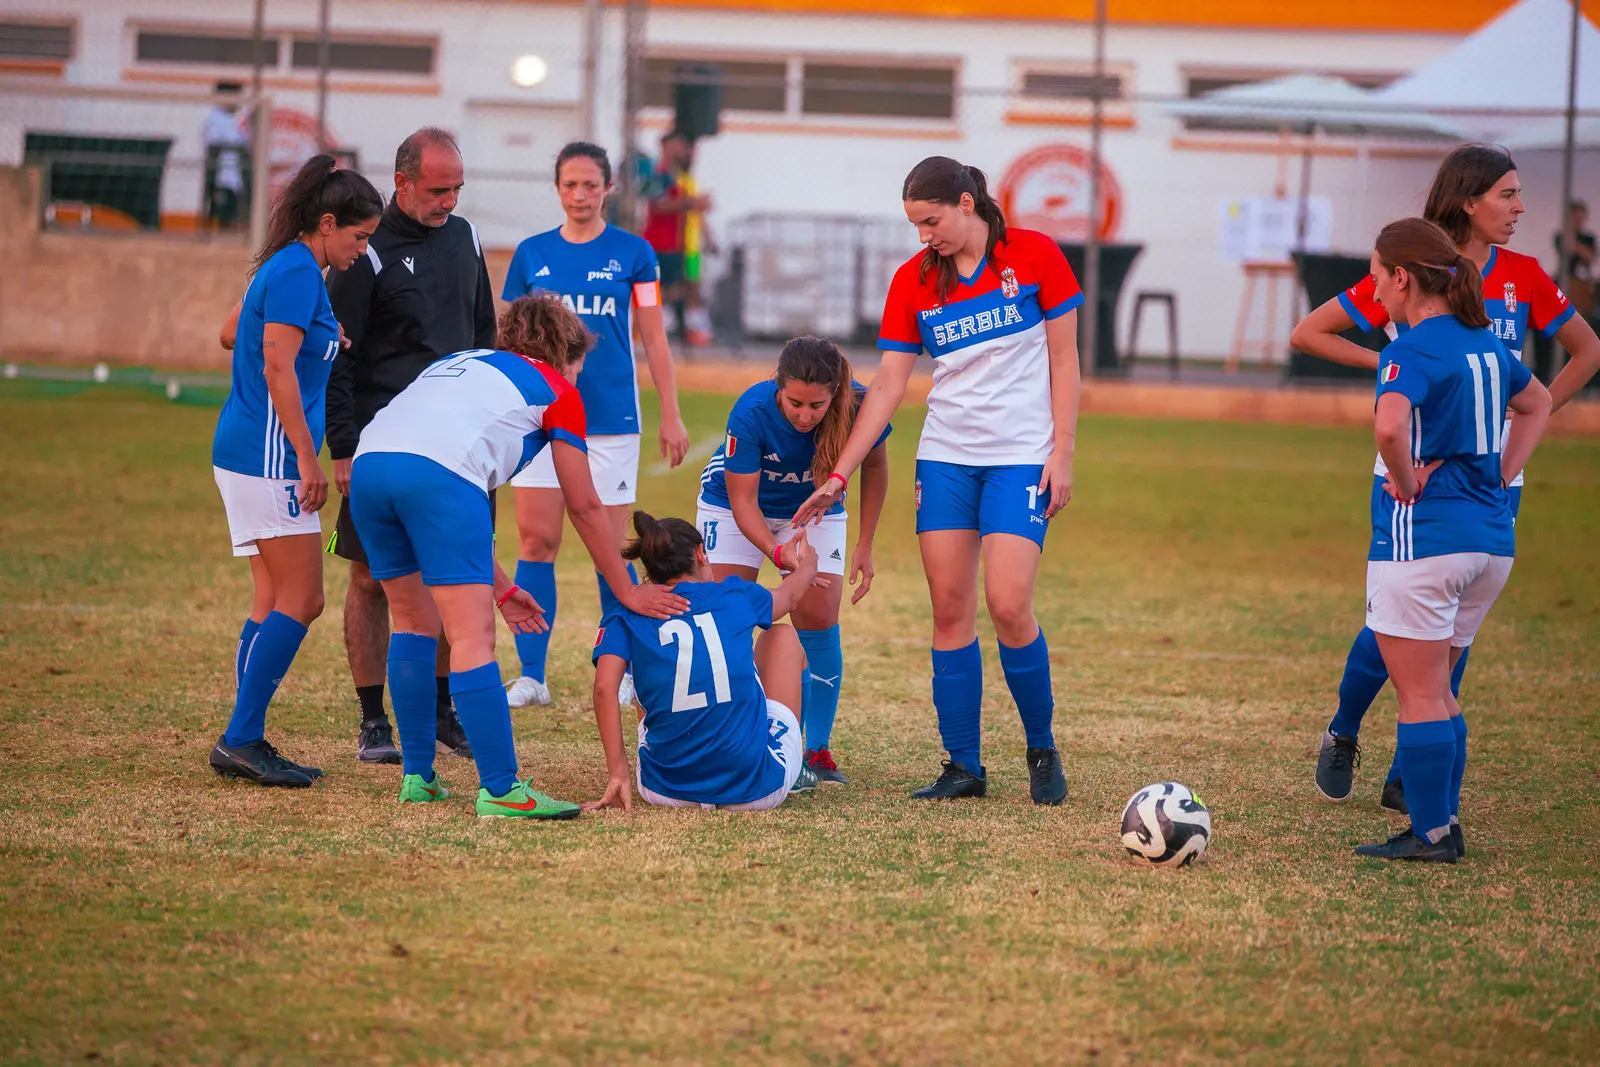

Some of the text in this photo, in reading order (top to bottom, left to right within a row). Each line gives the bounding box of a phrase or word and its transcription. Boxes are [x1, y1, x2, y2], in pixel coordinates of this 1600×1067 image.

[587, 271, 614, 281] pwc
[561, 294, 616, 316] ALIA
[921, 306, 943, 320] pwc
[933, 304, 1023, 346] SERBIA
[1466, 352, 1500, 455] 11
[285, 484, 300, 518] 3
[703, 521, 719, 551] 13
[658, 612, 731, 713] 21
